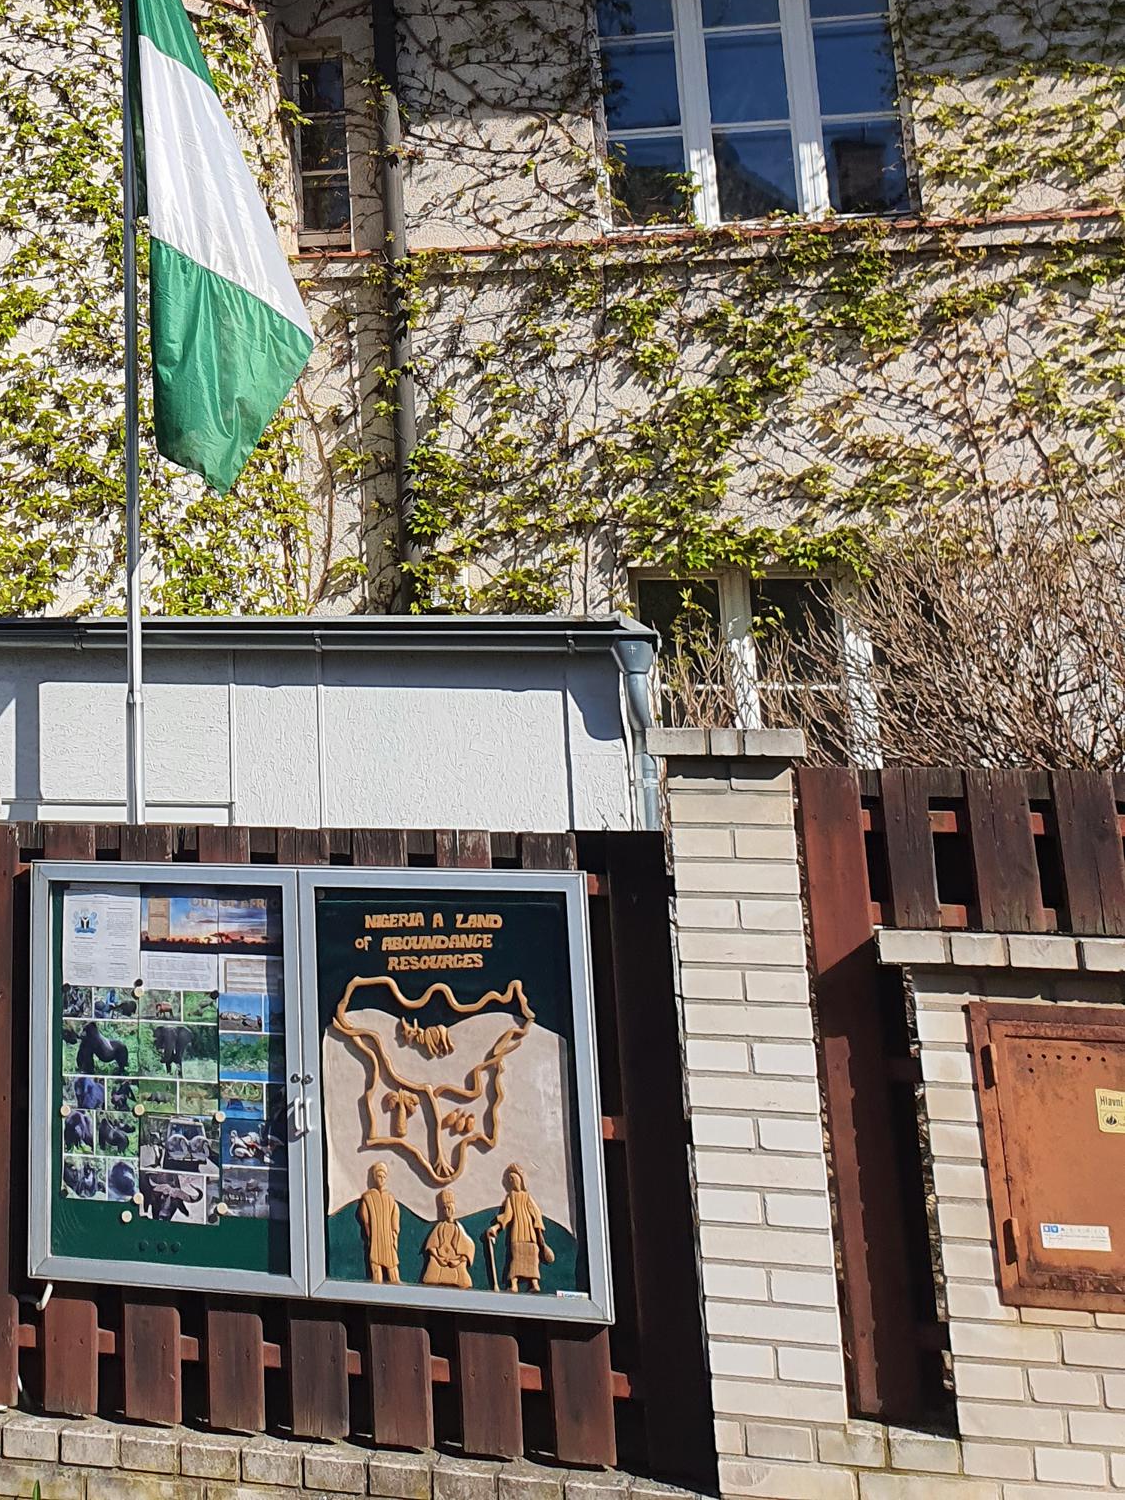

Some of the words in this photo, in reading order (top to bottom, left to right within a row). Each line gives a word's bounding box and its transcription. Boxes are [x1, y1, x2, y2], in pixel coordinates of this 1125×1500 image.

[364, 912, 425, 929] NIGERIA
[432, 912, 444, 928] A
[455, 913, 503, 929] LAND
[381, 934, 493, 951] ABOUNDANCE
[387, 953, 484, 971] RESOURCES
